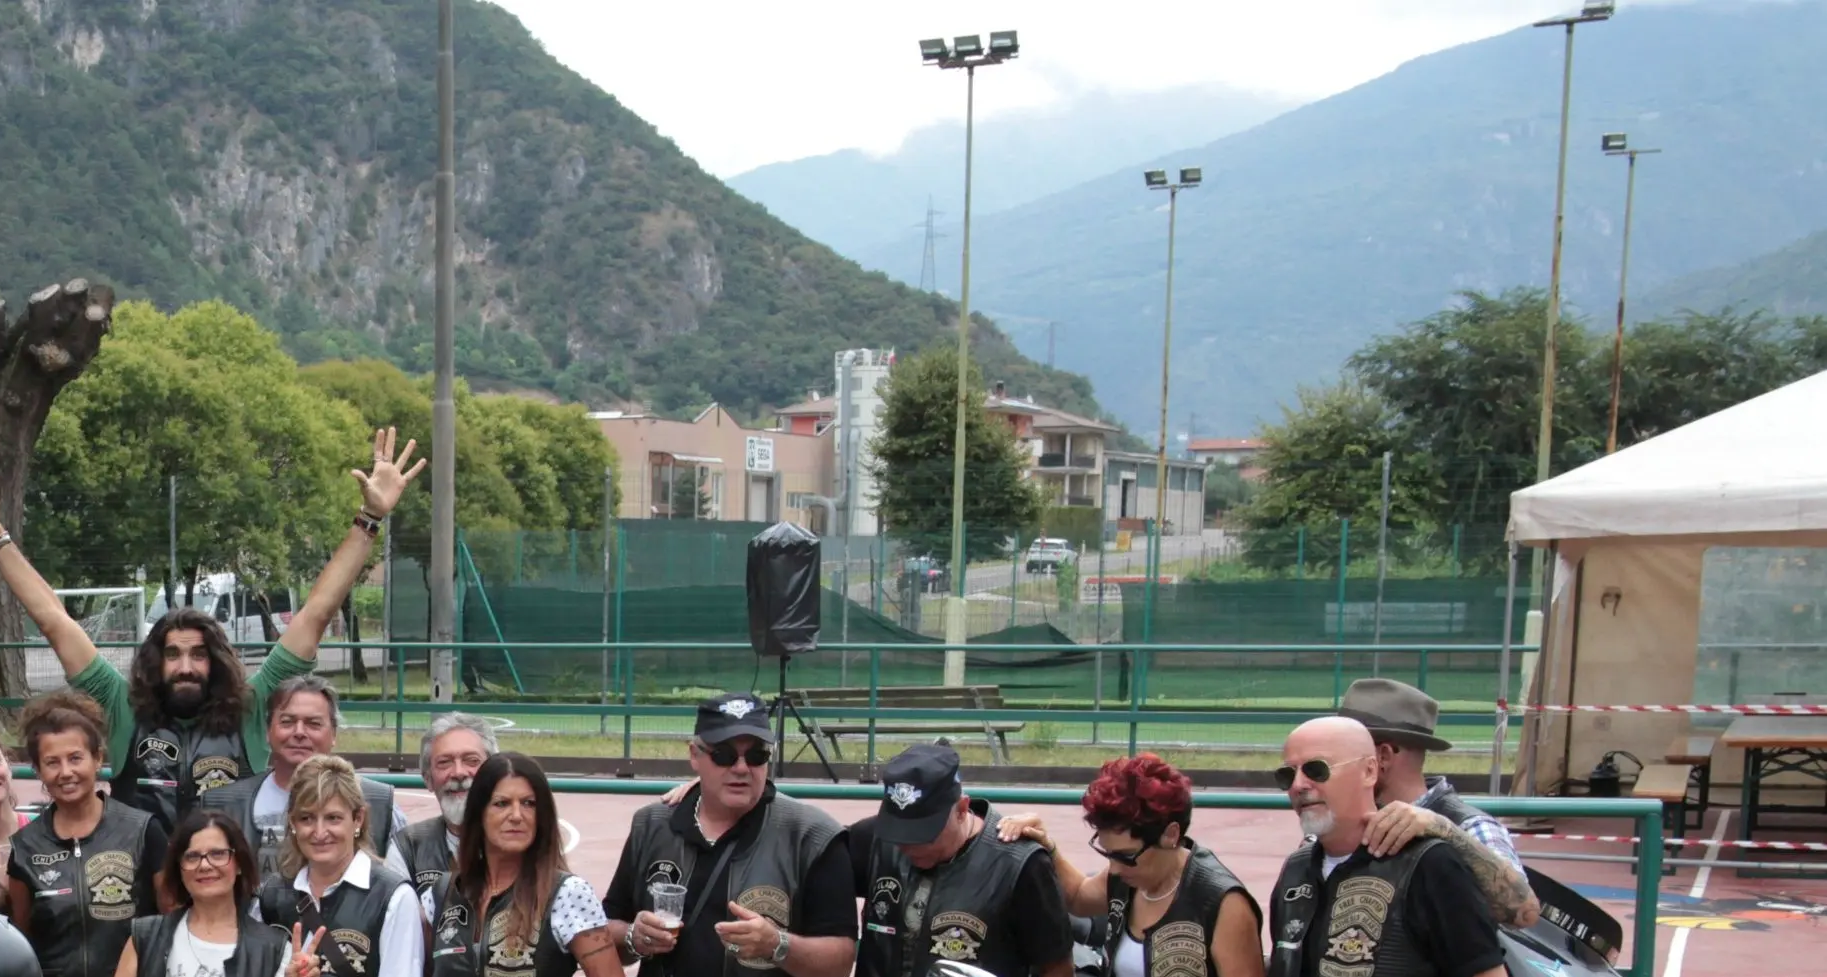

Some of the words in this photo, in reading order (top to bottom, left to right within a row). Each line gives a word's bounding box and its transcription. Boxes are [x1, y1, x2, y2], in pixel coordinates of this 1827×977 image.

[147, 740, 169, 750] EDDY
[658, 863, 673, 873] GIGI
[416, 873, 442, 883] GIORG
[1338, 896, 1355, 910] FREE
[1359, 896, 1383, 913] CHAPTER
[940, 915, 980, 928] PADAWAN
[1156, 961, 1170, 973] FREE
[1173, 956, 1202, 971] CHAPTER
